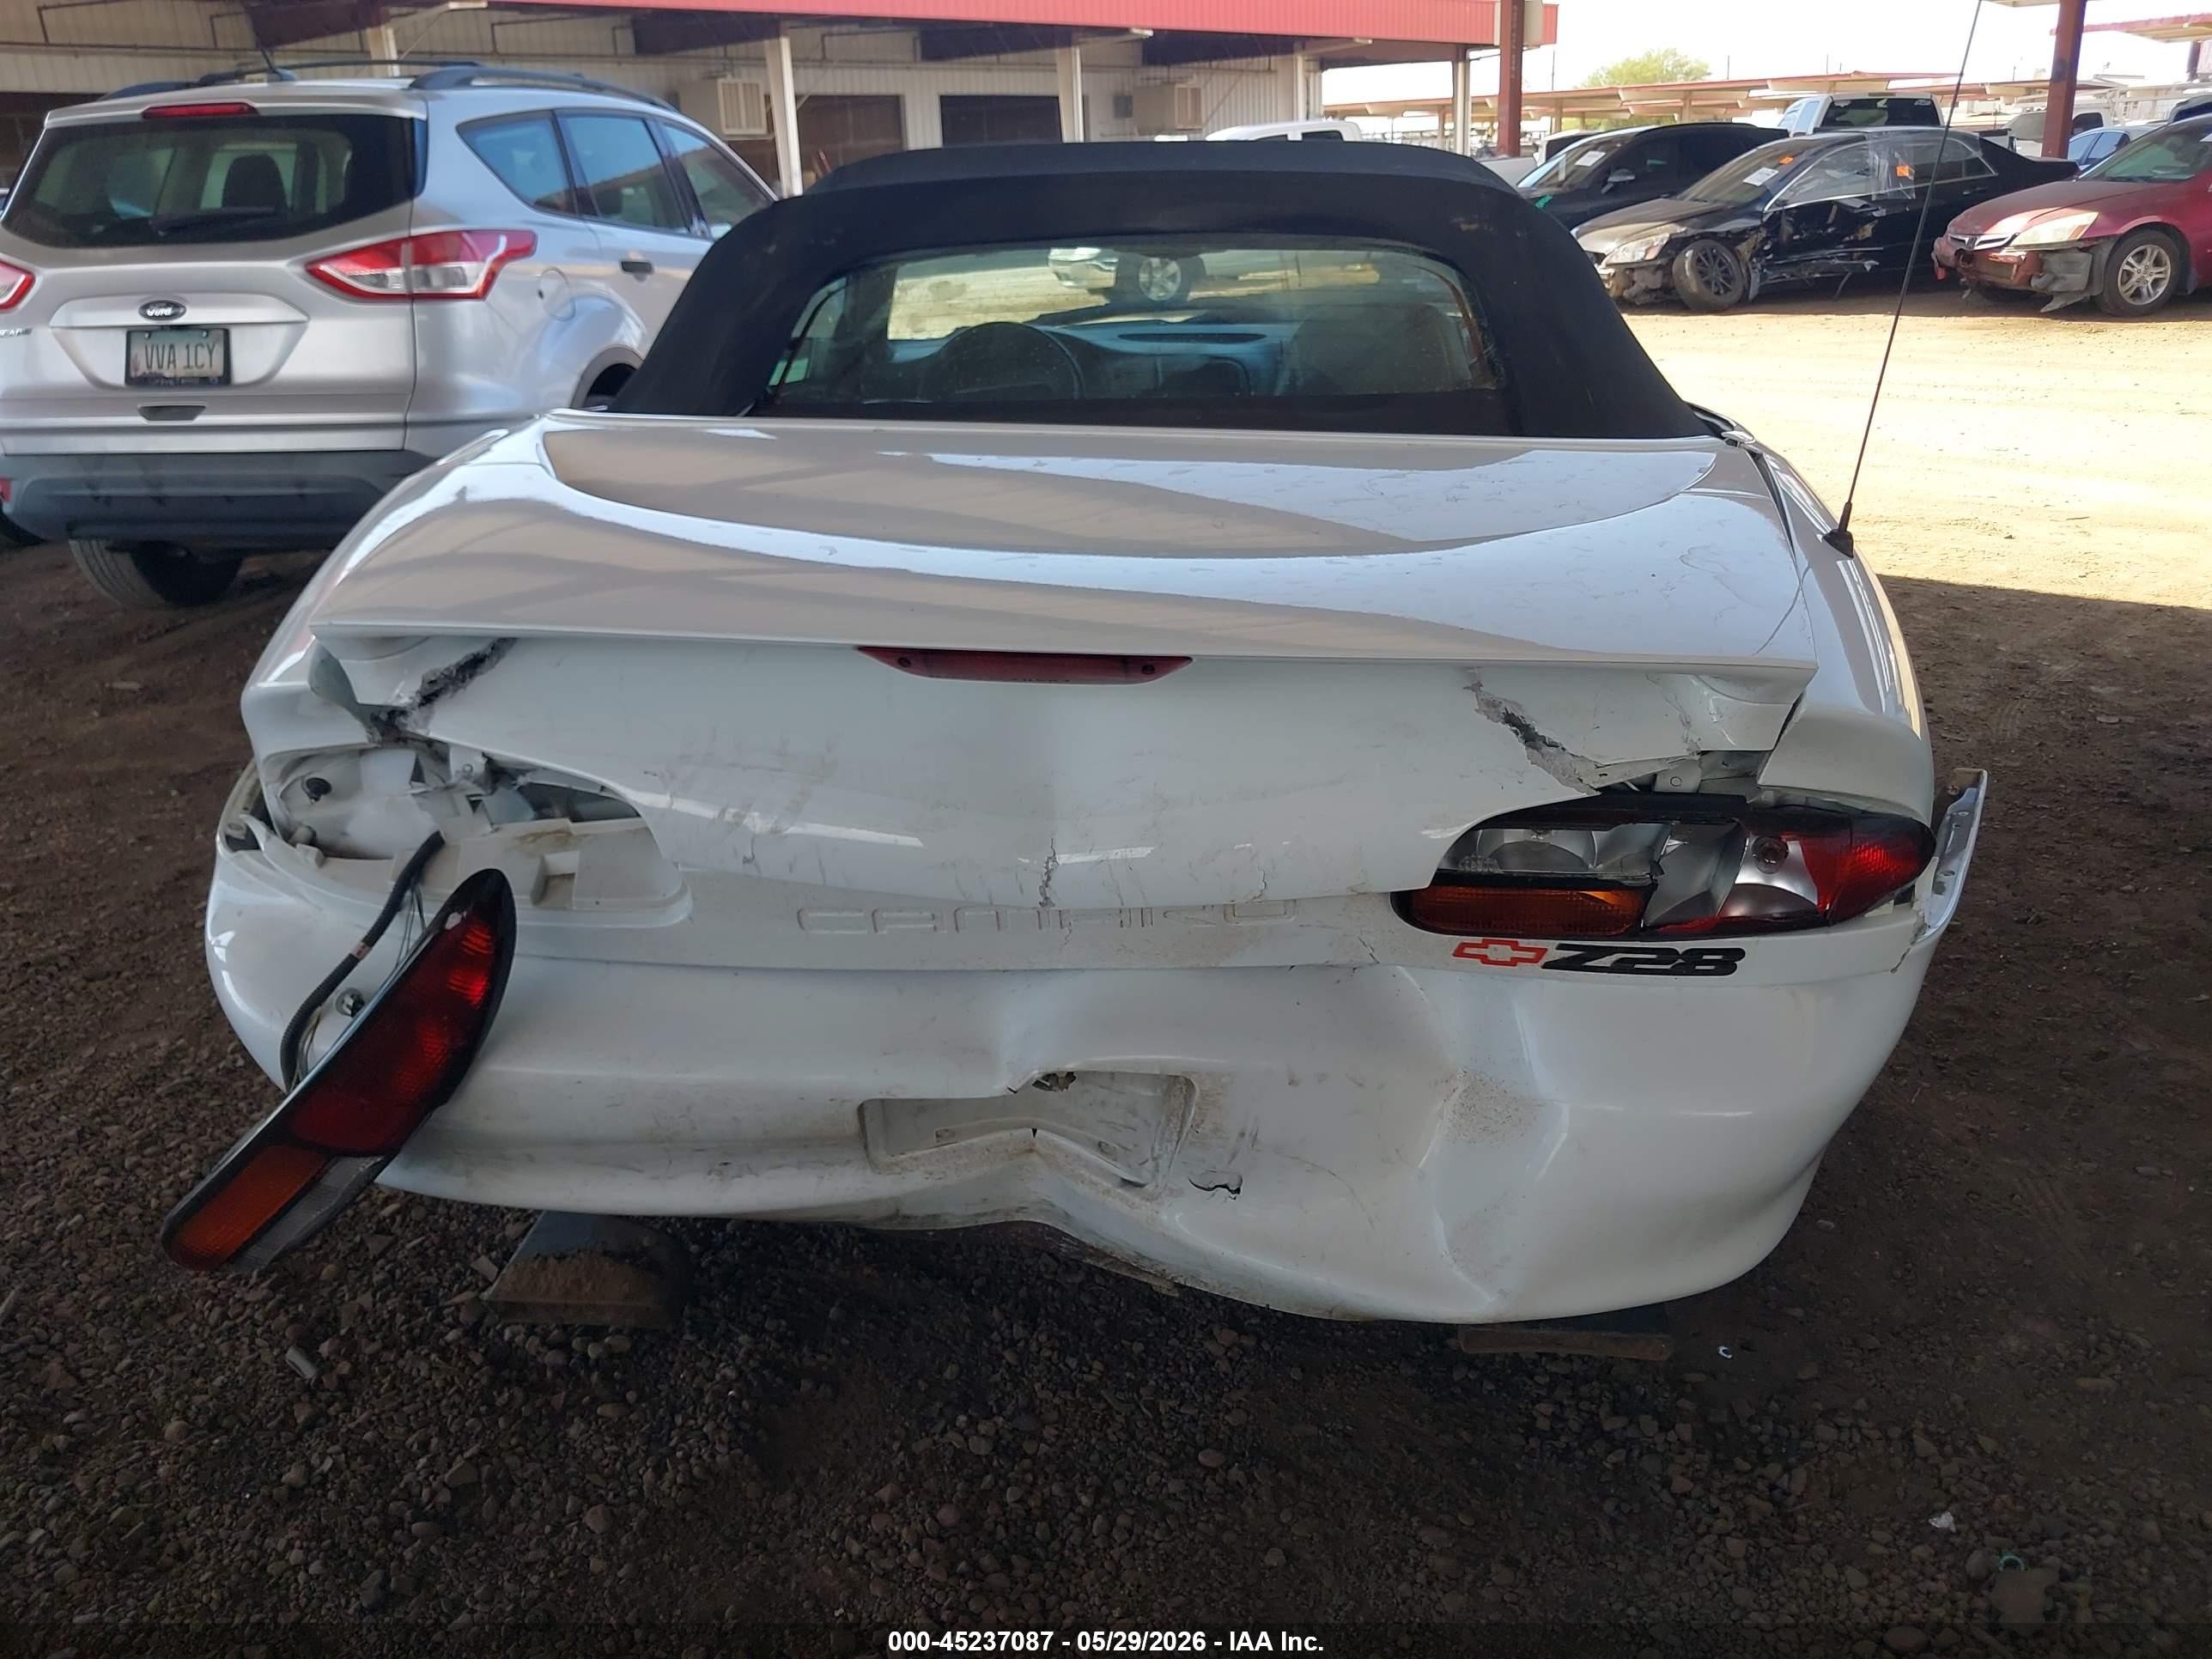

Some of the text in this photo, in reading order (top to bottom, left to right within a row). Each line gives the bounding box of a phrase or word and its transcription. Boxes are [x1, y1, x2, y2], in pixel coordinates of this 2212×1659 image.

[143, 304, 177, 319] Ford
[144, 342, 216, 370] VVA 1CY
[1541, 943, 1746, 976] Z28
